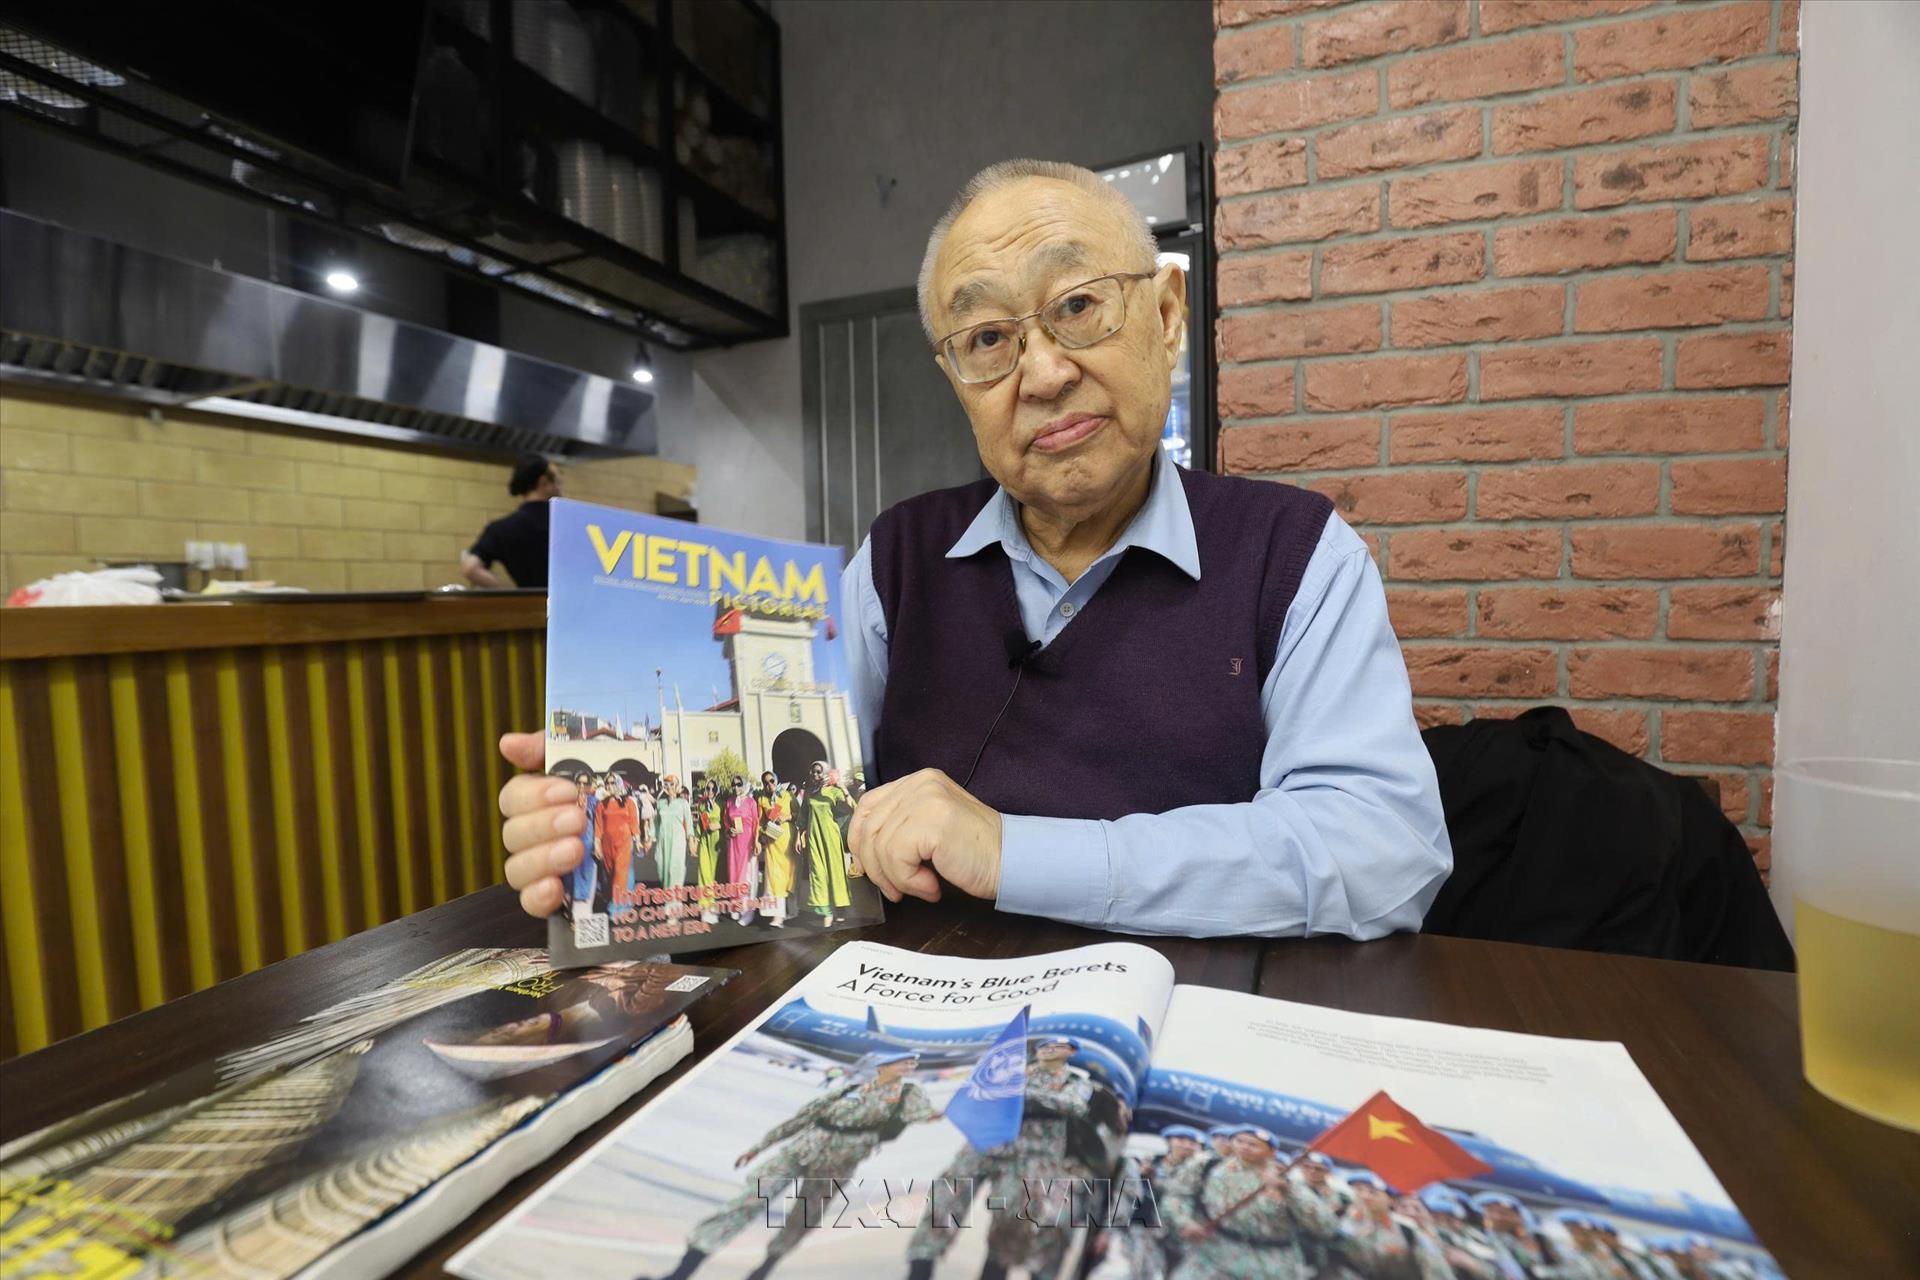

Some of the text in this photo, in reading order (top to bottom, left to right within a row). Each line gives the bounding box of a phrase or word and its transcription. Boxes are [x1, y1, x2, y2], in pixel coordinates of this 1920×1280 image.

[586, 524, 828, 604] VIETNAM
[612, 881, 749, 905] Infrastructure
[612, 919, 712, 943] TO A NEW ERA
[858, 961, 1128, 989] Vietnam's Blue Berets
[836, 979, 857, 992] A
[863, 982, 936, 1004] Force
[941, 993, 982, 1004] for
[986, 979, 1061, 1002] Good
